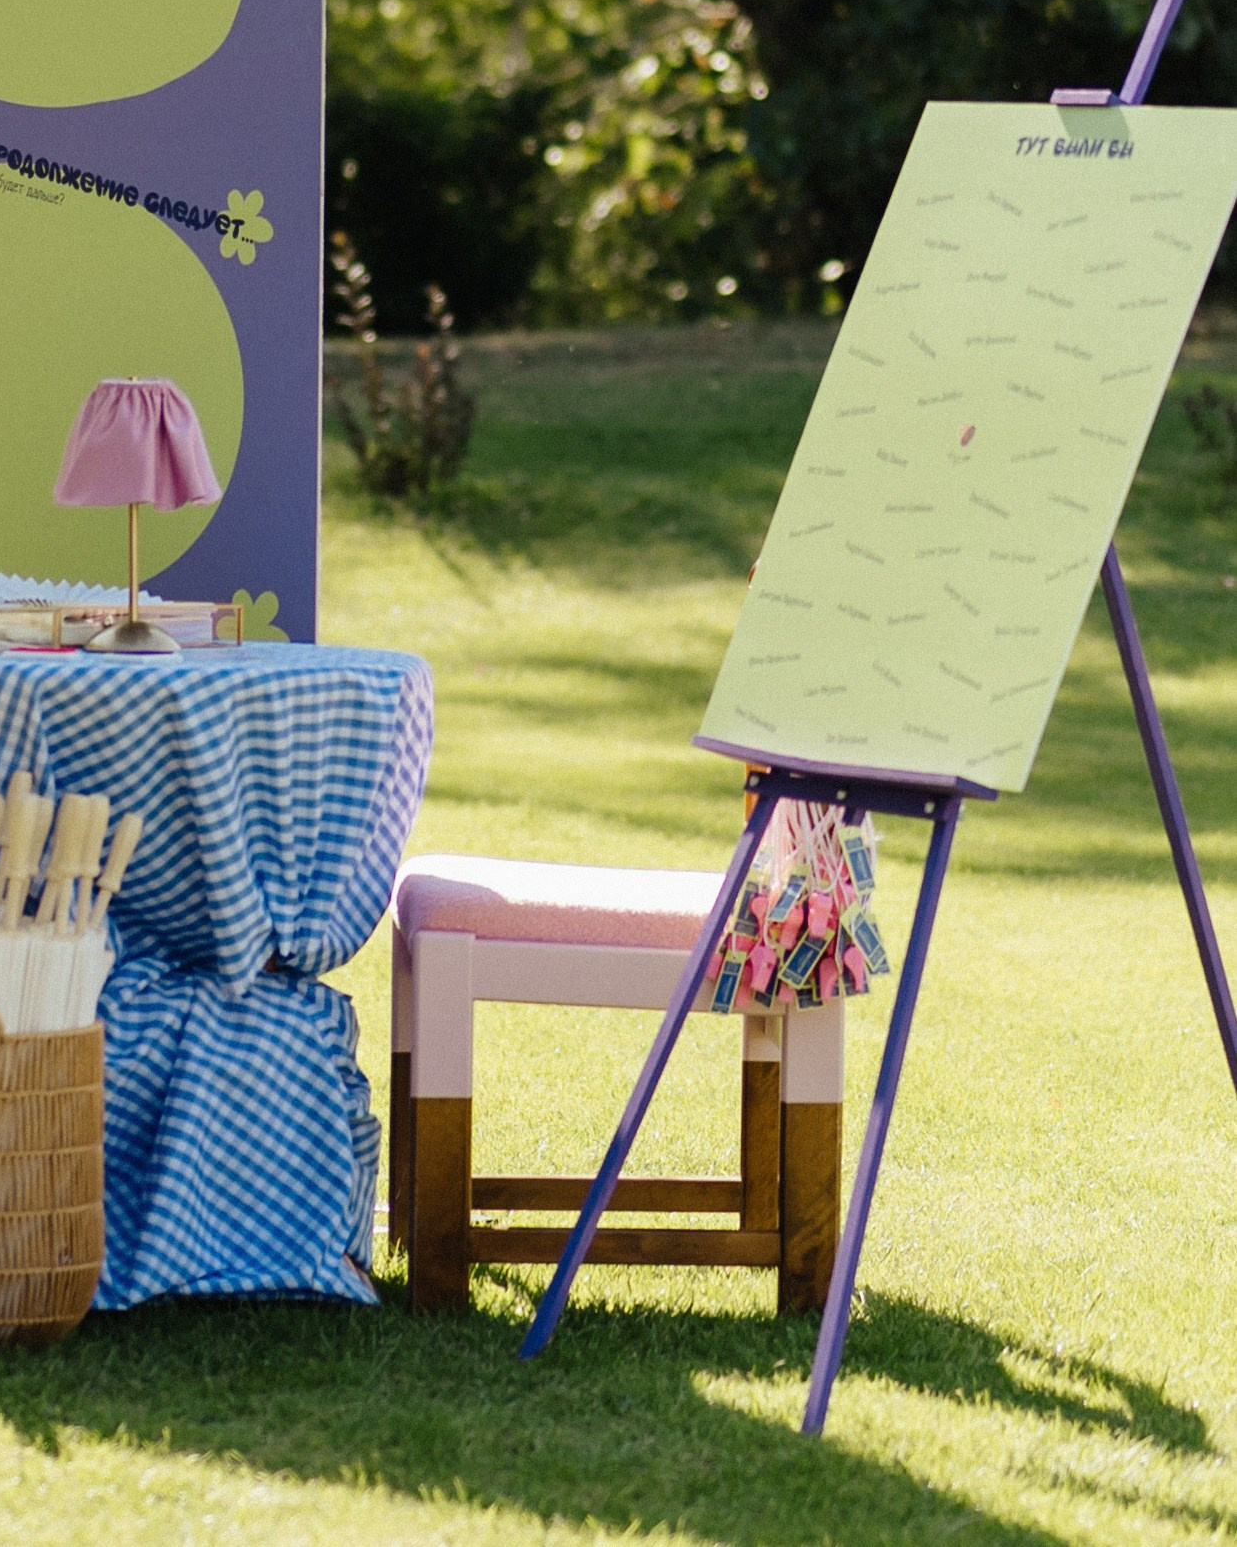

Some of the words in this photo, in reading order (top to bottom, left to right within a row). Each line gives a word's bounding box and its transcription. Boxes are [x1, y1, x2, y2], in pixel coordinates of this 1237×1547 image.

[1016, 136, 1049, 156] ТУТ
[1053, 137, 1104, 158] БЫЛИ
[1108, 139, 1134, 159] ВЫ
[26, 186, 65, 205] дальше?
